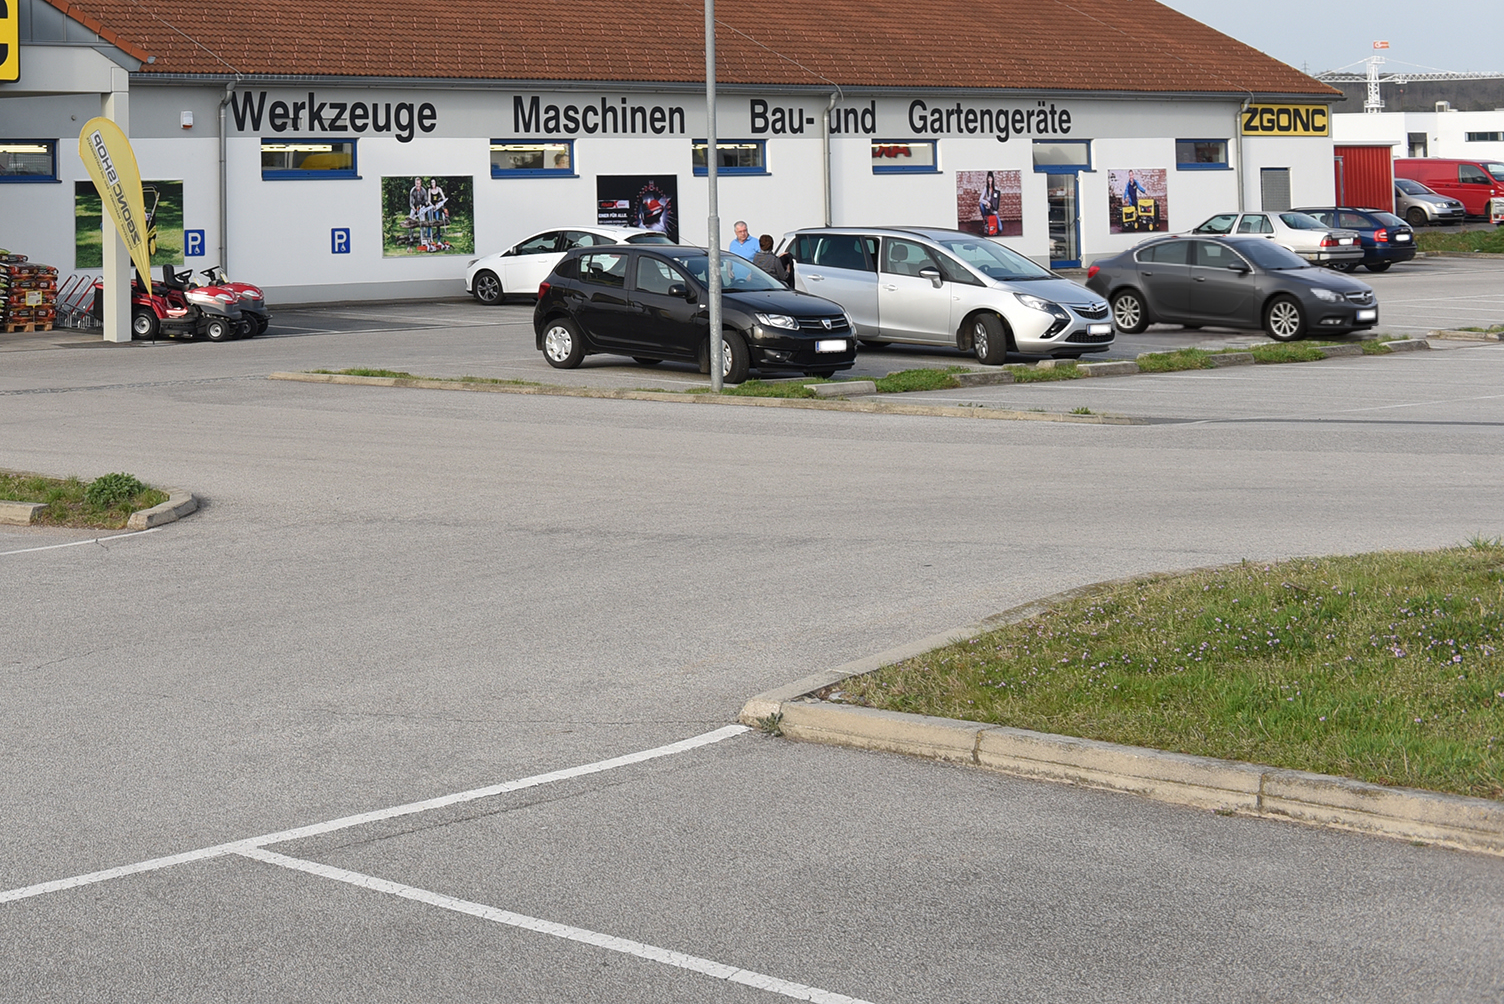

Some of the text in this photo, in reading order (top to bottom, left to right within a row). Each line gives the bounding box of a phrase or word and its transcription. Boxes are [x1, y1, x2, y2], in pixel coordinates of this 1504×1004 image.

[232, 91, 1072, 143] Werkzeuge Maschinen Bau- und Gartengeräte
[1241, 107, 1327, 132] ZGONC
[188, 232, 202, 255] P
[334, 230, 347, 252] P
